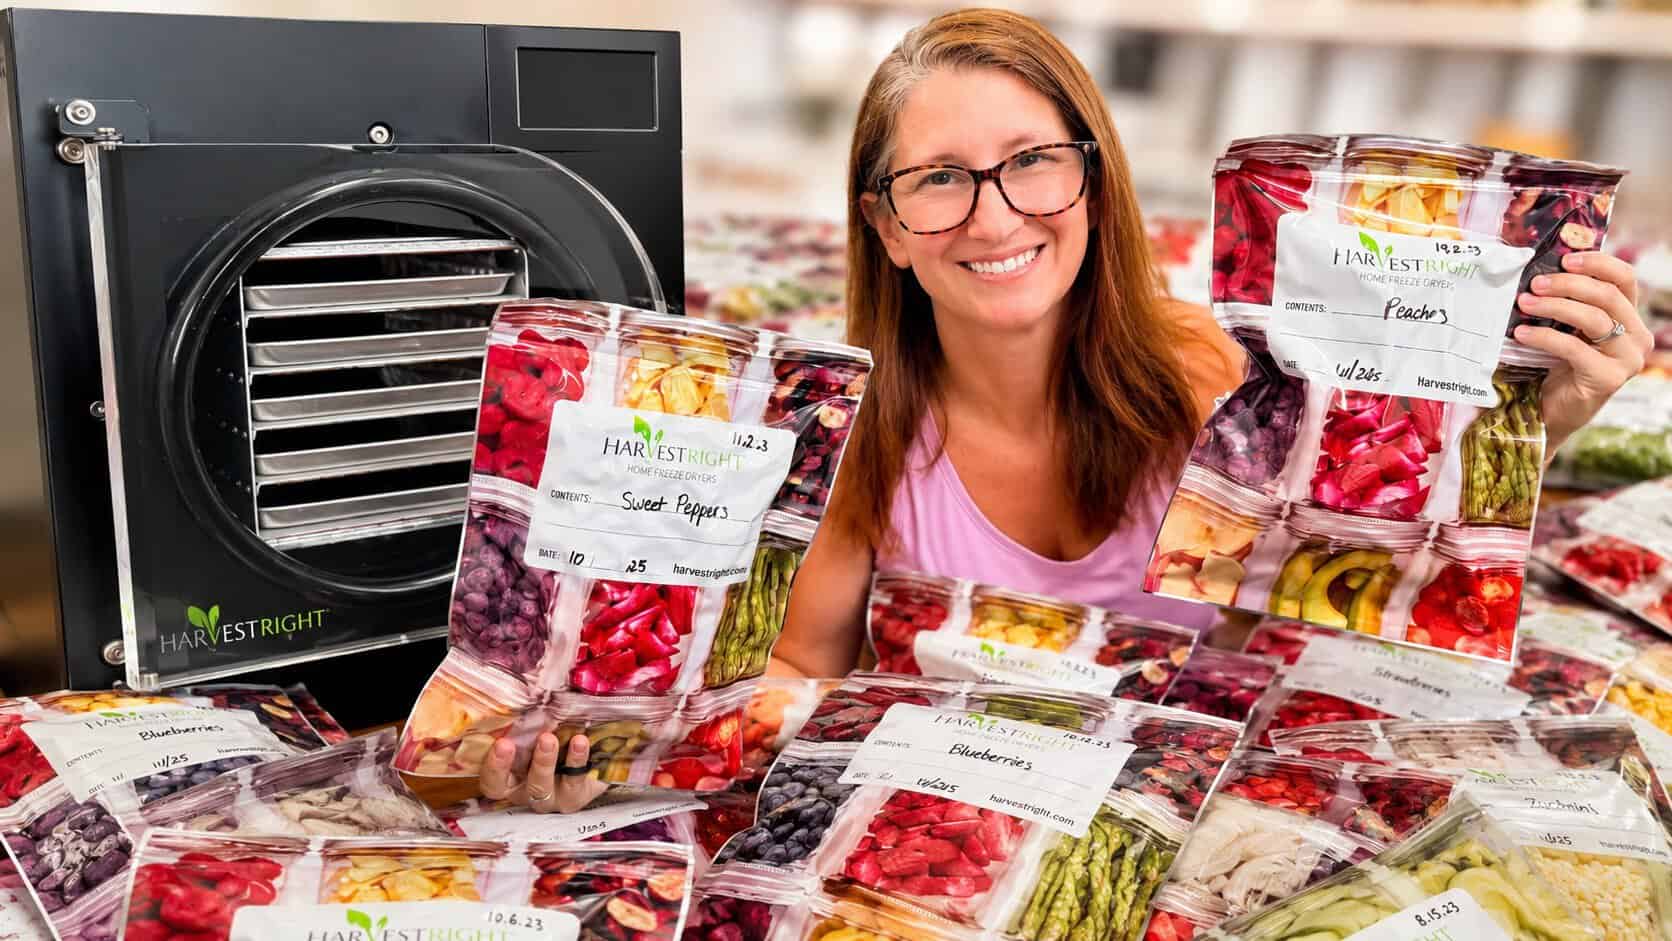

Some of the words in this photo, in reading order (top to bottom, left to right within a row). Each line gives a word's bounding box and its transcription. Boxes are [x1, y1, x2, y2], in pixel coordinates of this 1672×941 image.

[1359, 272, 1387, 284] HOME
[1388, 275, 1421, 287] FREEZE
[603, 425, 745, 472] HARVESTRIGHT
[627, 463, 652, 476] HOME
[654, 466, 685, 481] FREEZE
[550, 489, 592, 504] CONTENTS:
[622, 491, 668, 512] Sweet
[160, 605, 327, 654] HARVESTRIGHT
[488, 910, 544, 931] 10.6.23
[1414, 901, 1460, 927] 8.15.23
